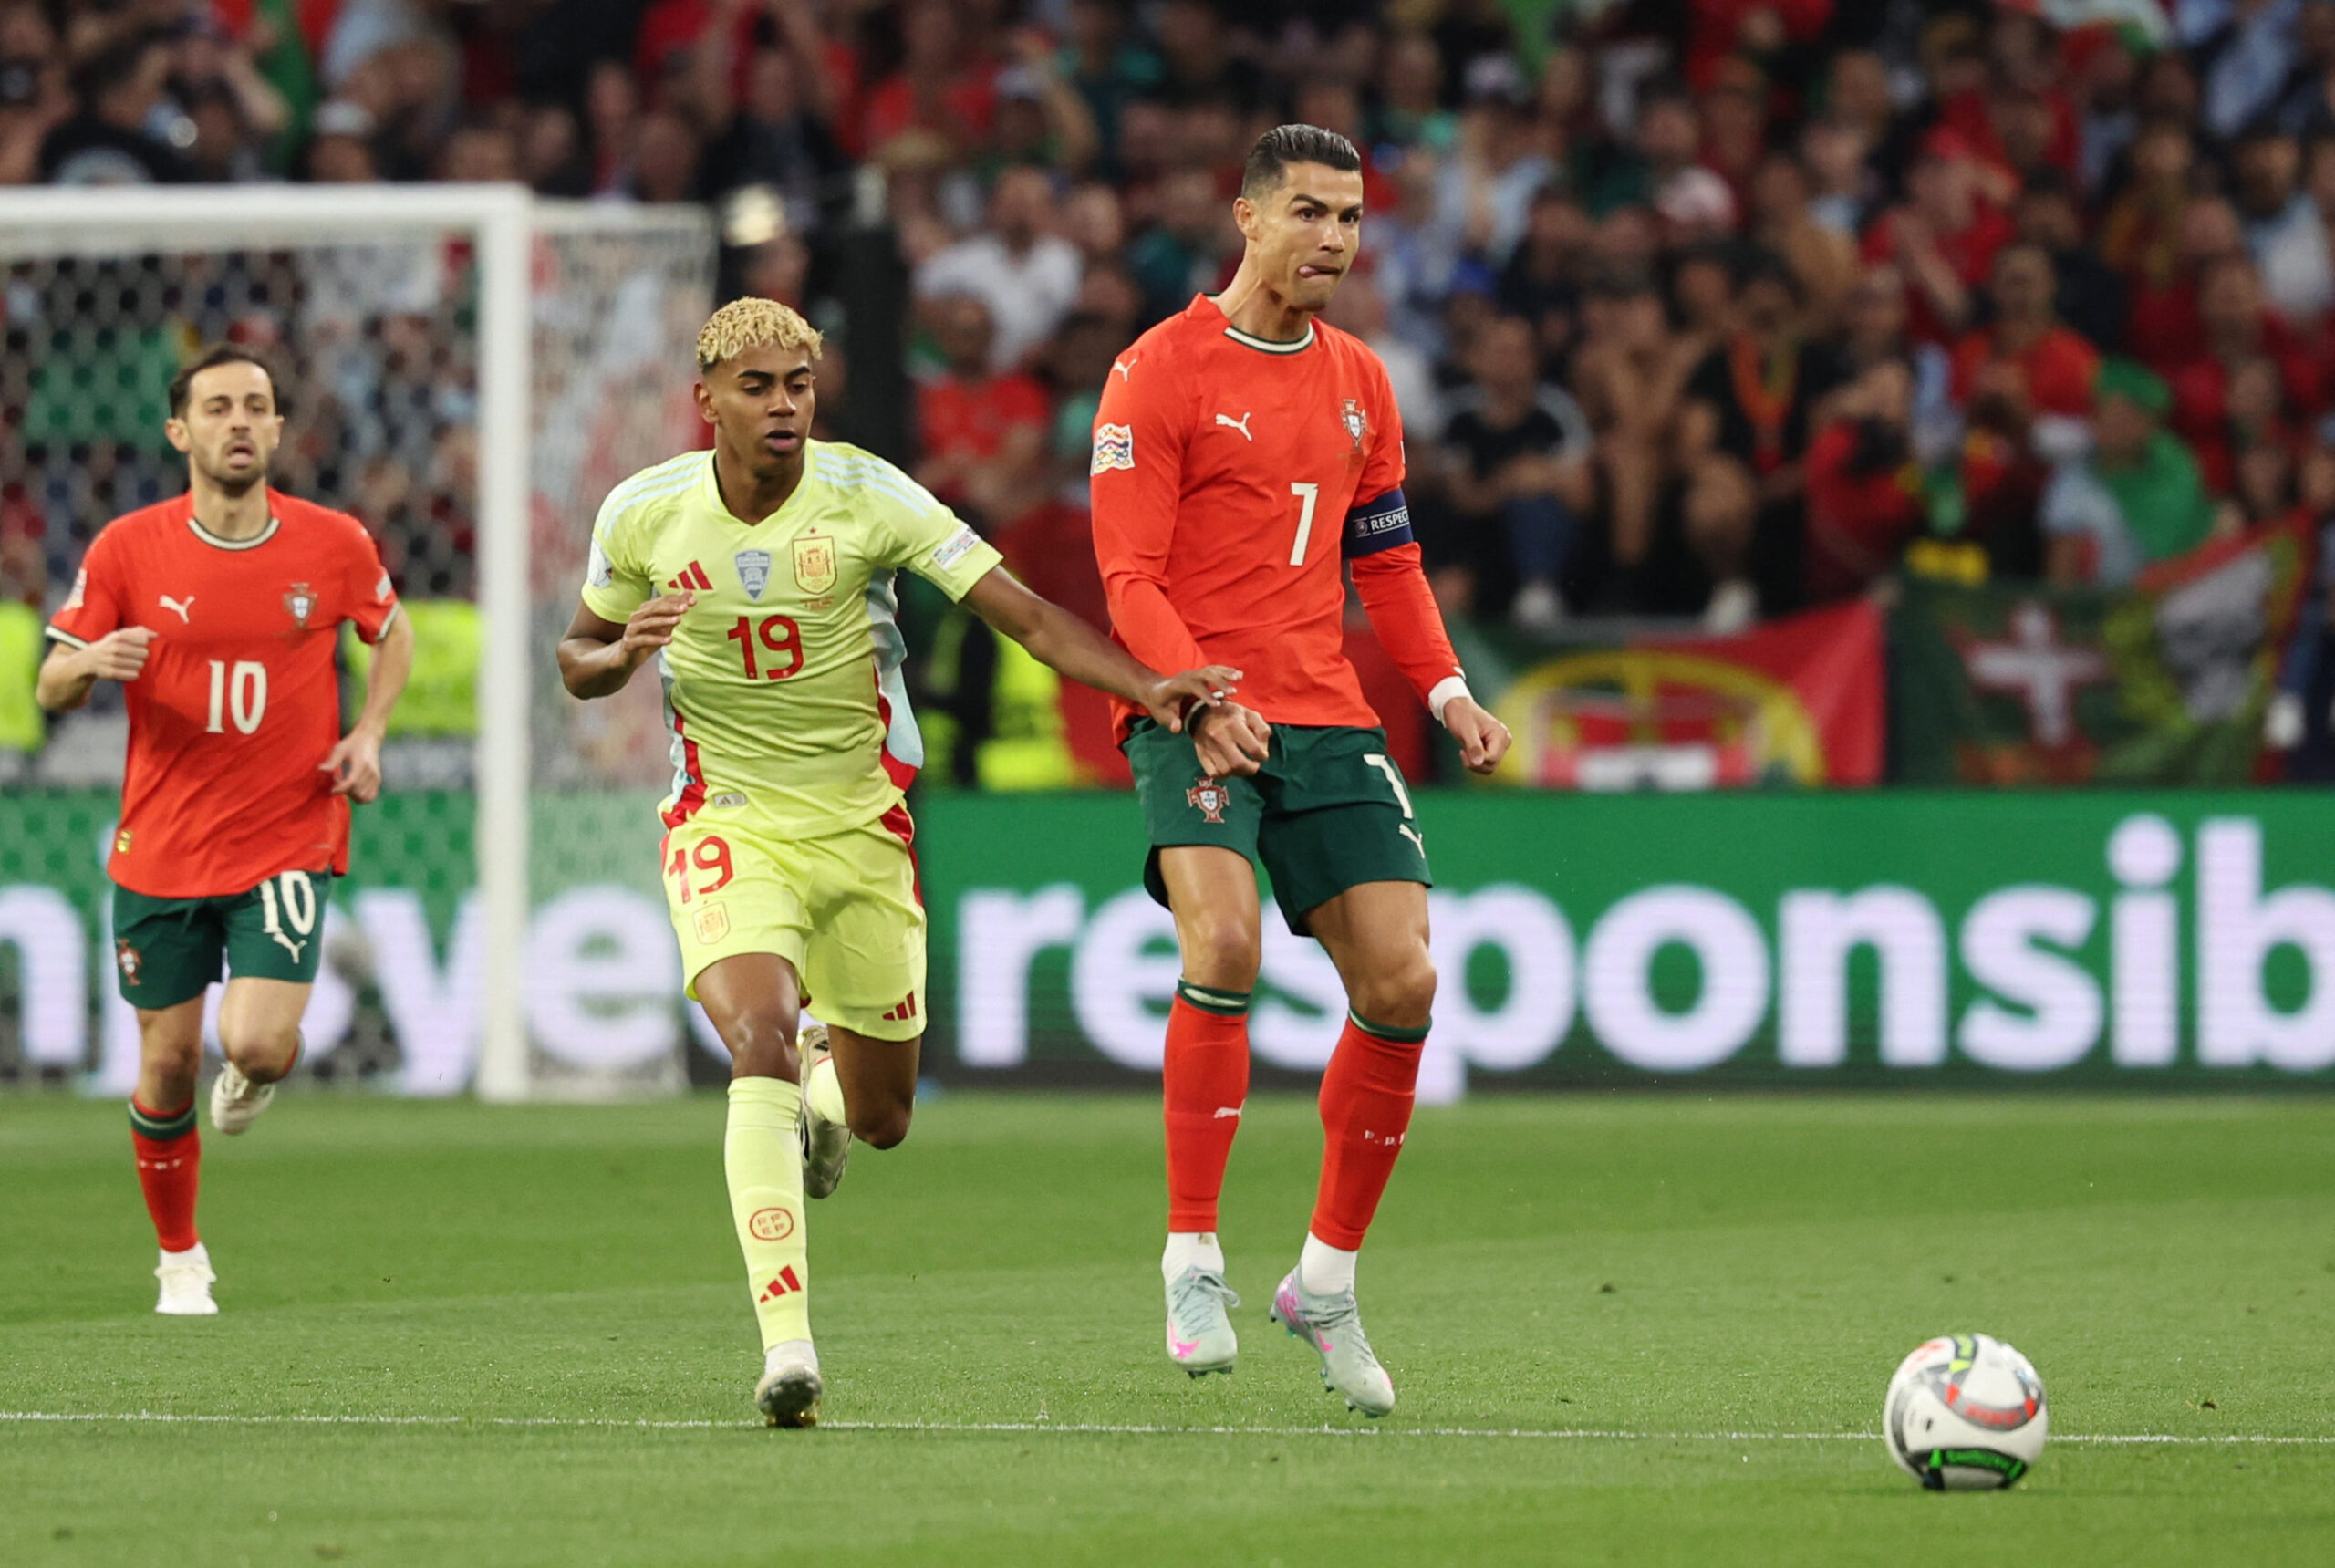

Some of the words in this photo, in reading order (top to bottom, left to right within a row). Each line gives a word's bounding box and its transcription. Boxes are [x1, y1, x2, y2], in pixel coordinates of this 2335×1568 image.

[1289, 482, 1319, 566] 7
[726, 614, 804, 680] 19
[205, 659, 268, 735] 10
[1363, 753, 1413, 820] 7
[258, 869, 317, 935] 10
[668, 836, 734, 905] 19
